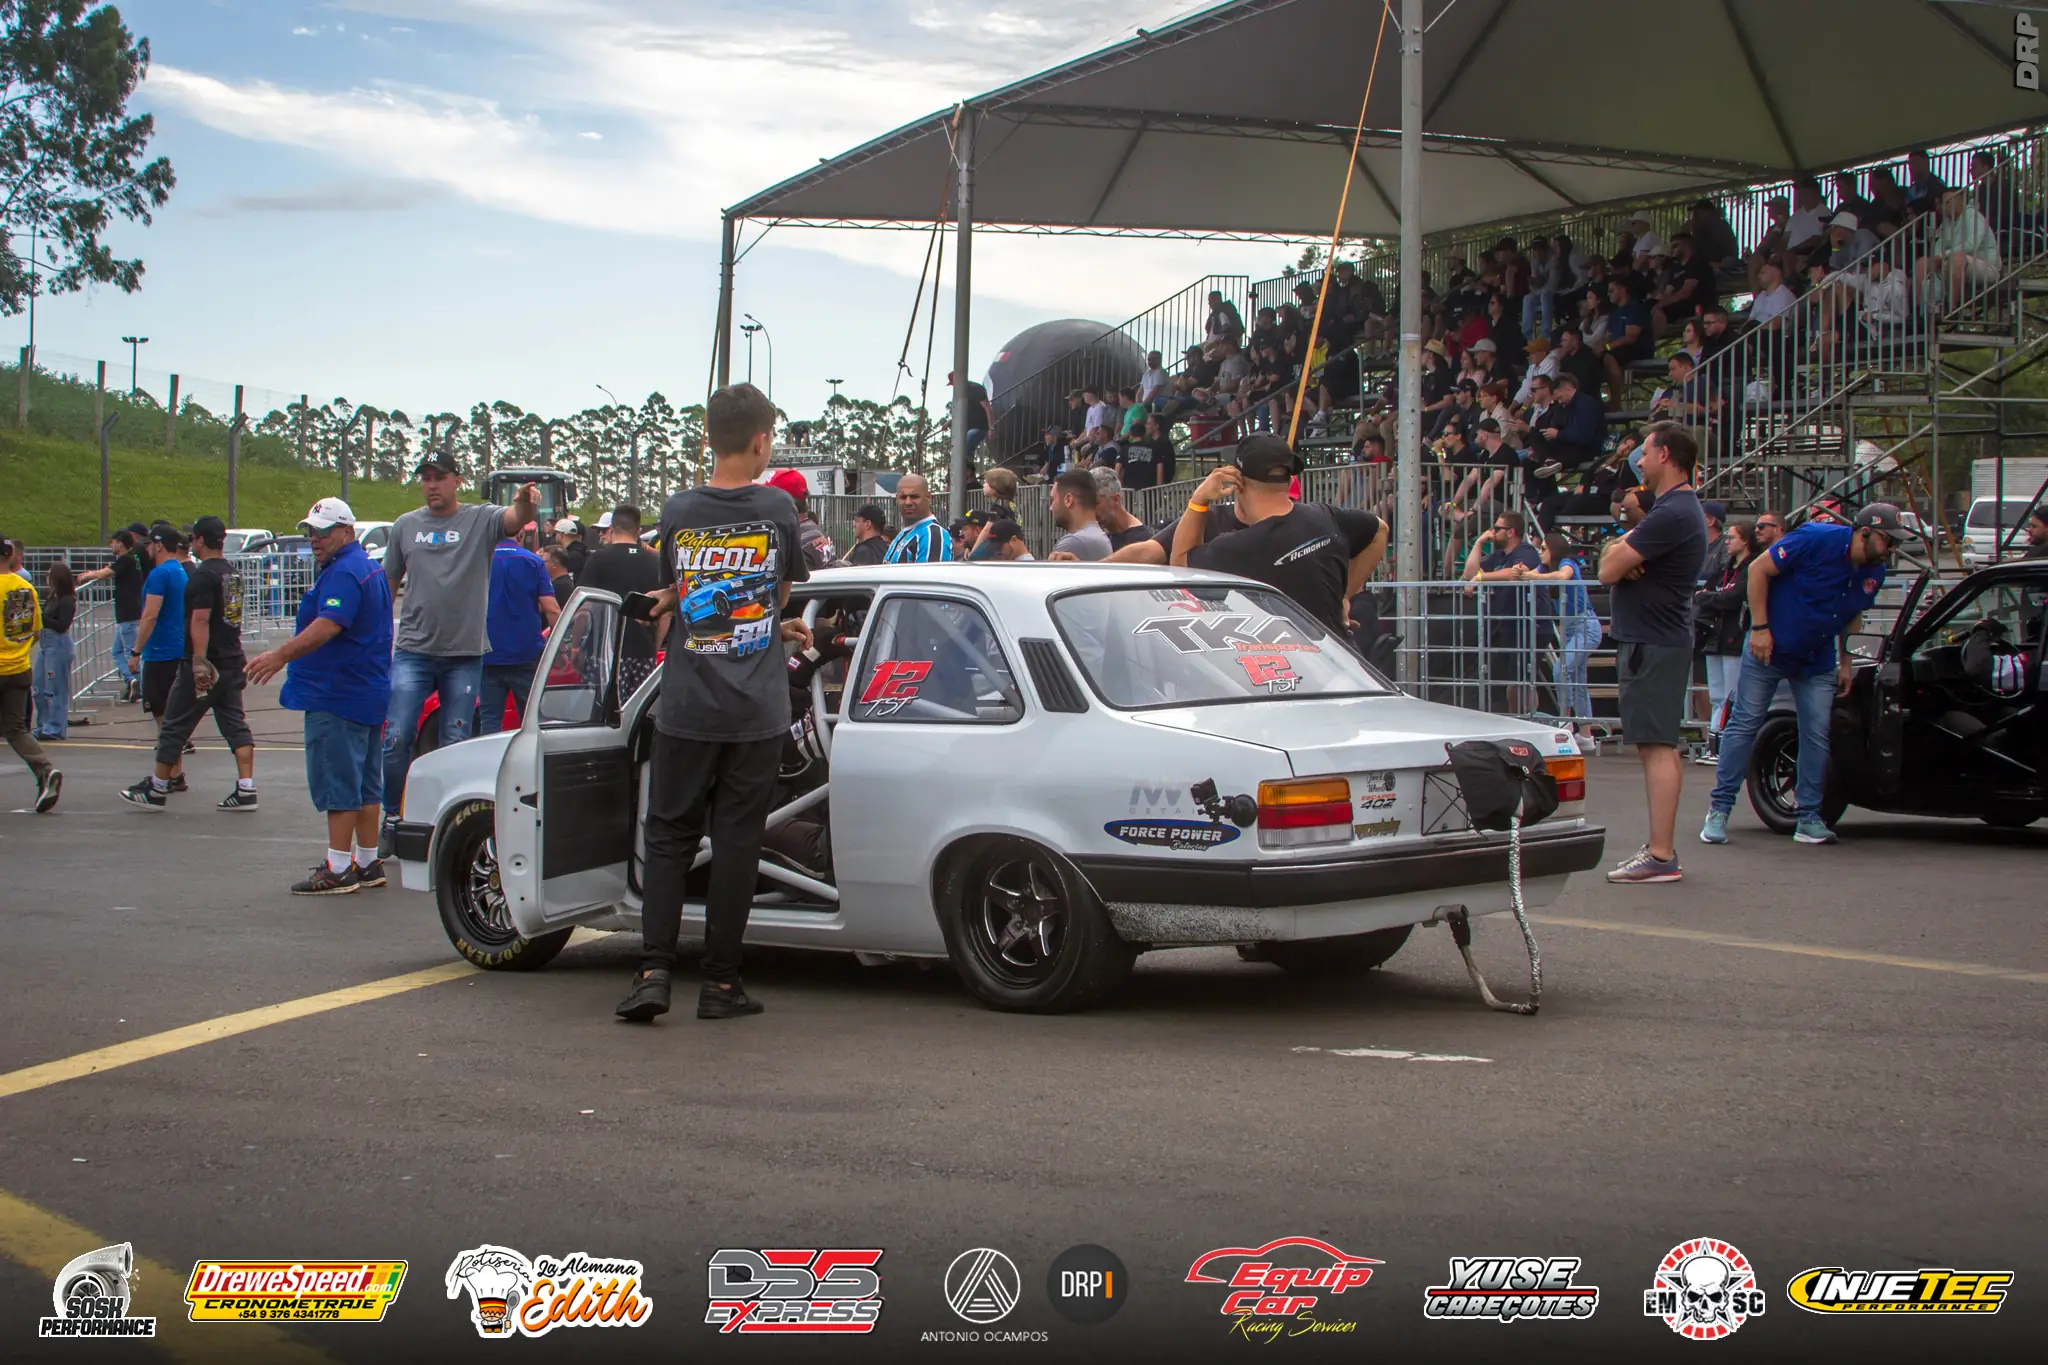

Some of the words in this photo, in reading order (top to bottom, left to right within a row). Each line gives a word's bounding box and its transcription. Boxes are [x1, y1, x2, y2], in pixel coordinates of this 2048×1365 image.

[675, 528, 731, 565] Rafael
[676, 546, 777, 573] NICOLA
[860, 660, 933, 704] 12
[1236, 655, 1299, 686] 12
[864, 696, 919, 717] TST
[1119, 826, 1166, 838] FORCE
[1170, 828, 1222, 842] POWER
